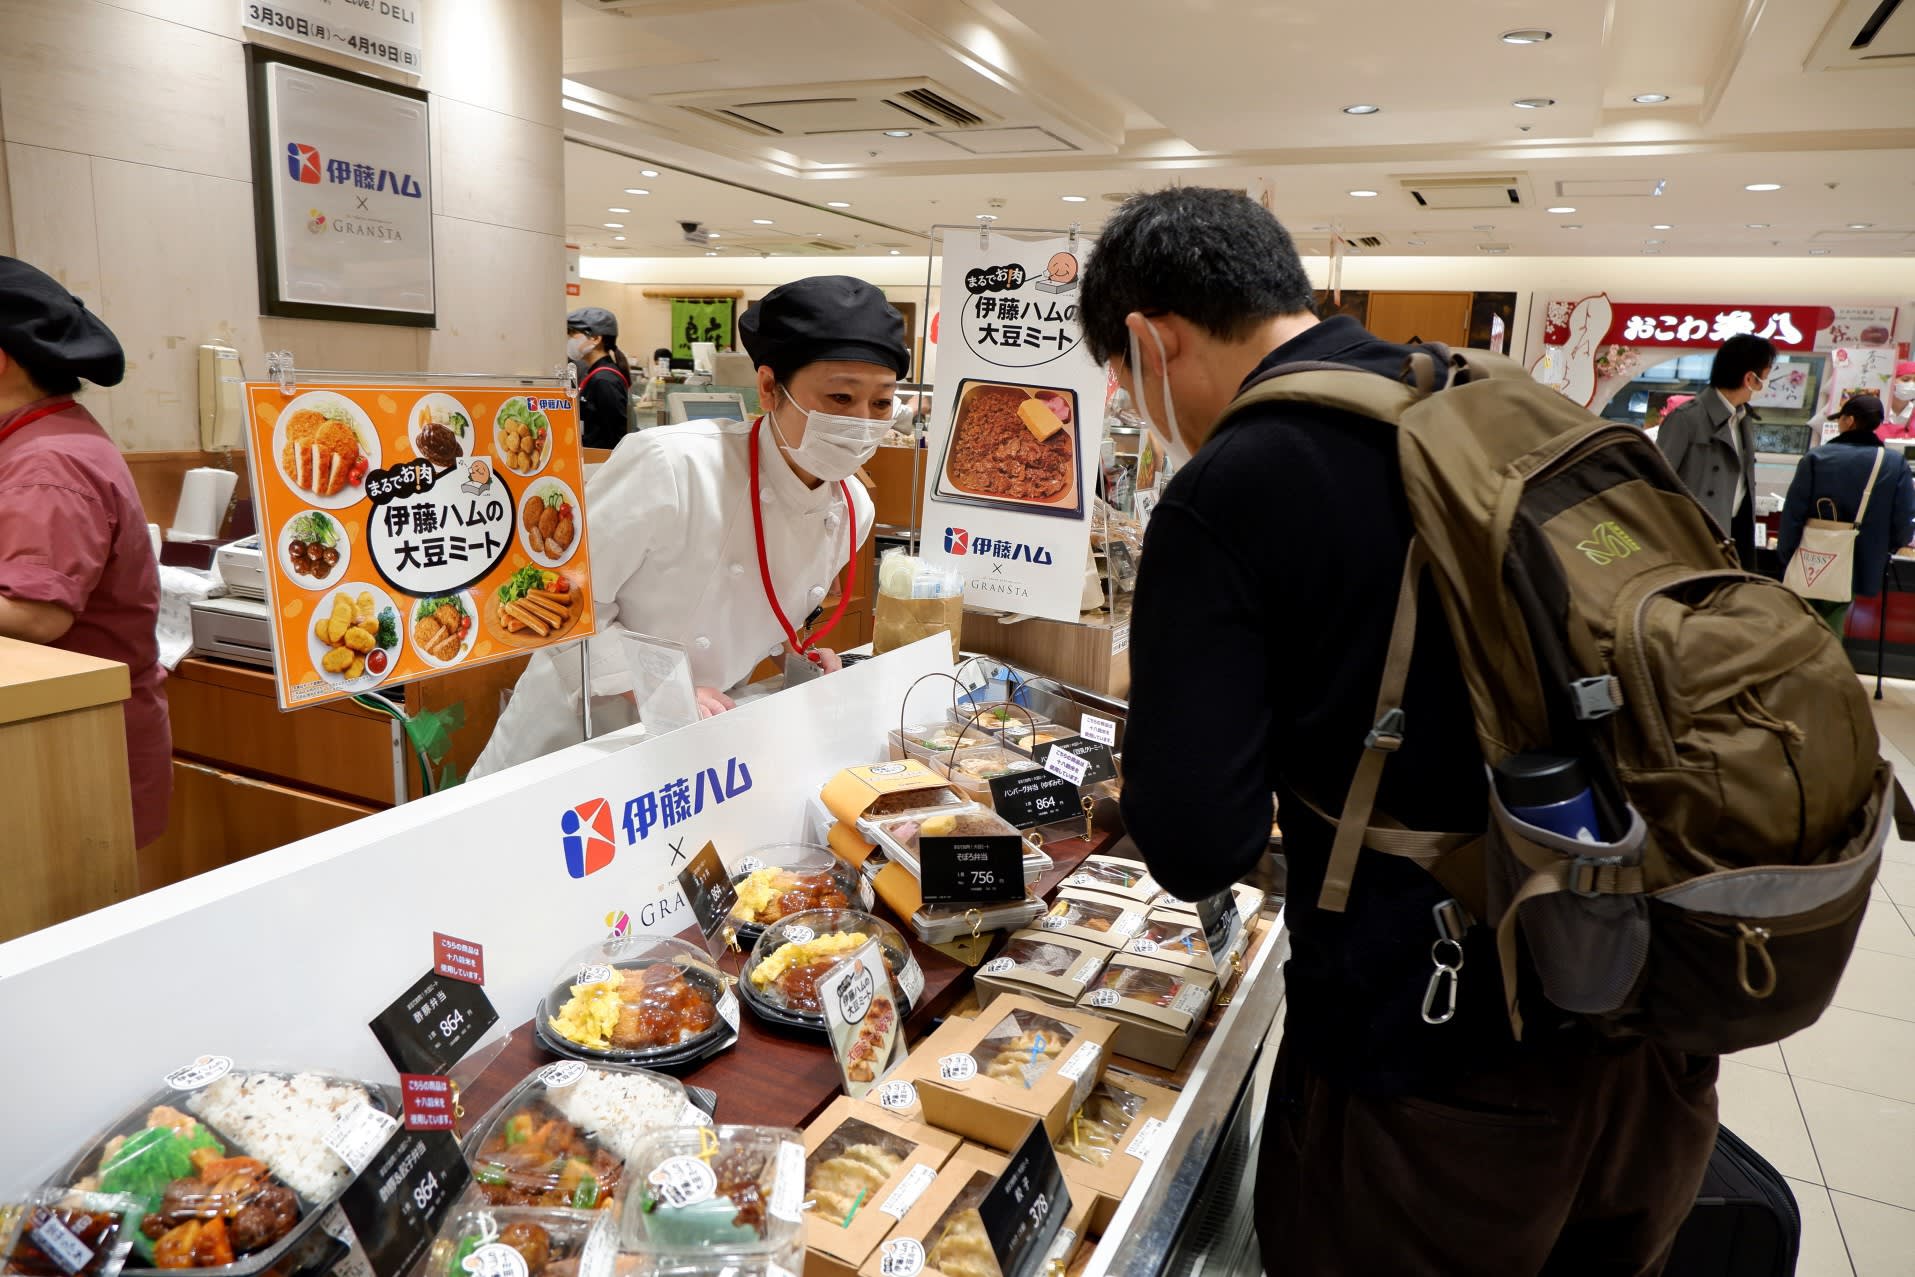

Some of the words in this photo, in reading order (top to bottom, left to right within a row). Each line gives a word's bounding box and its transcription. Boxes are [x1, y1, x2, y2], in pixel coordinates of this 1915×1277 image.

[380, 2, 414, 24] DELI
[326, 158, 422, 199] 伊藤ハム
[978, 322, 1074, 351] 大豆ミート
[540, 399, 572, 409] 伊藤ハム
[384, 500, 504, 537] 伊藤ハムの
[395, 531, 501, 572] 大豆ミート
[971, 536, 1053, 566] 伊藤ハム
[622, 757, 753, 846] 伊藤ハム
[1035, 795, 1056, 811] 864
[970, 870, 995, 885] 756
[439, 1009, 464, 1037] 864
[413, 1170, 439, 1210] 864
[1028, 1193, 1049, 1229] 378
